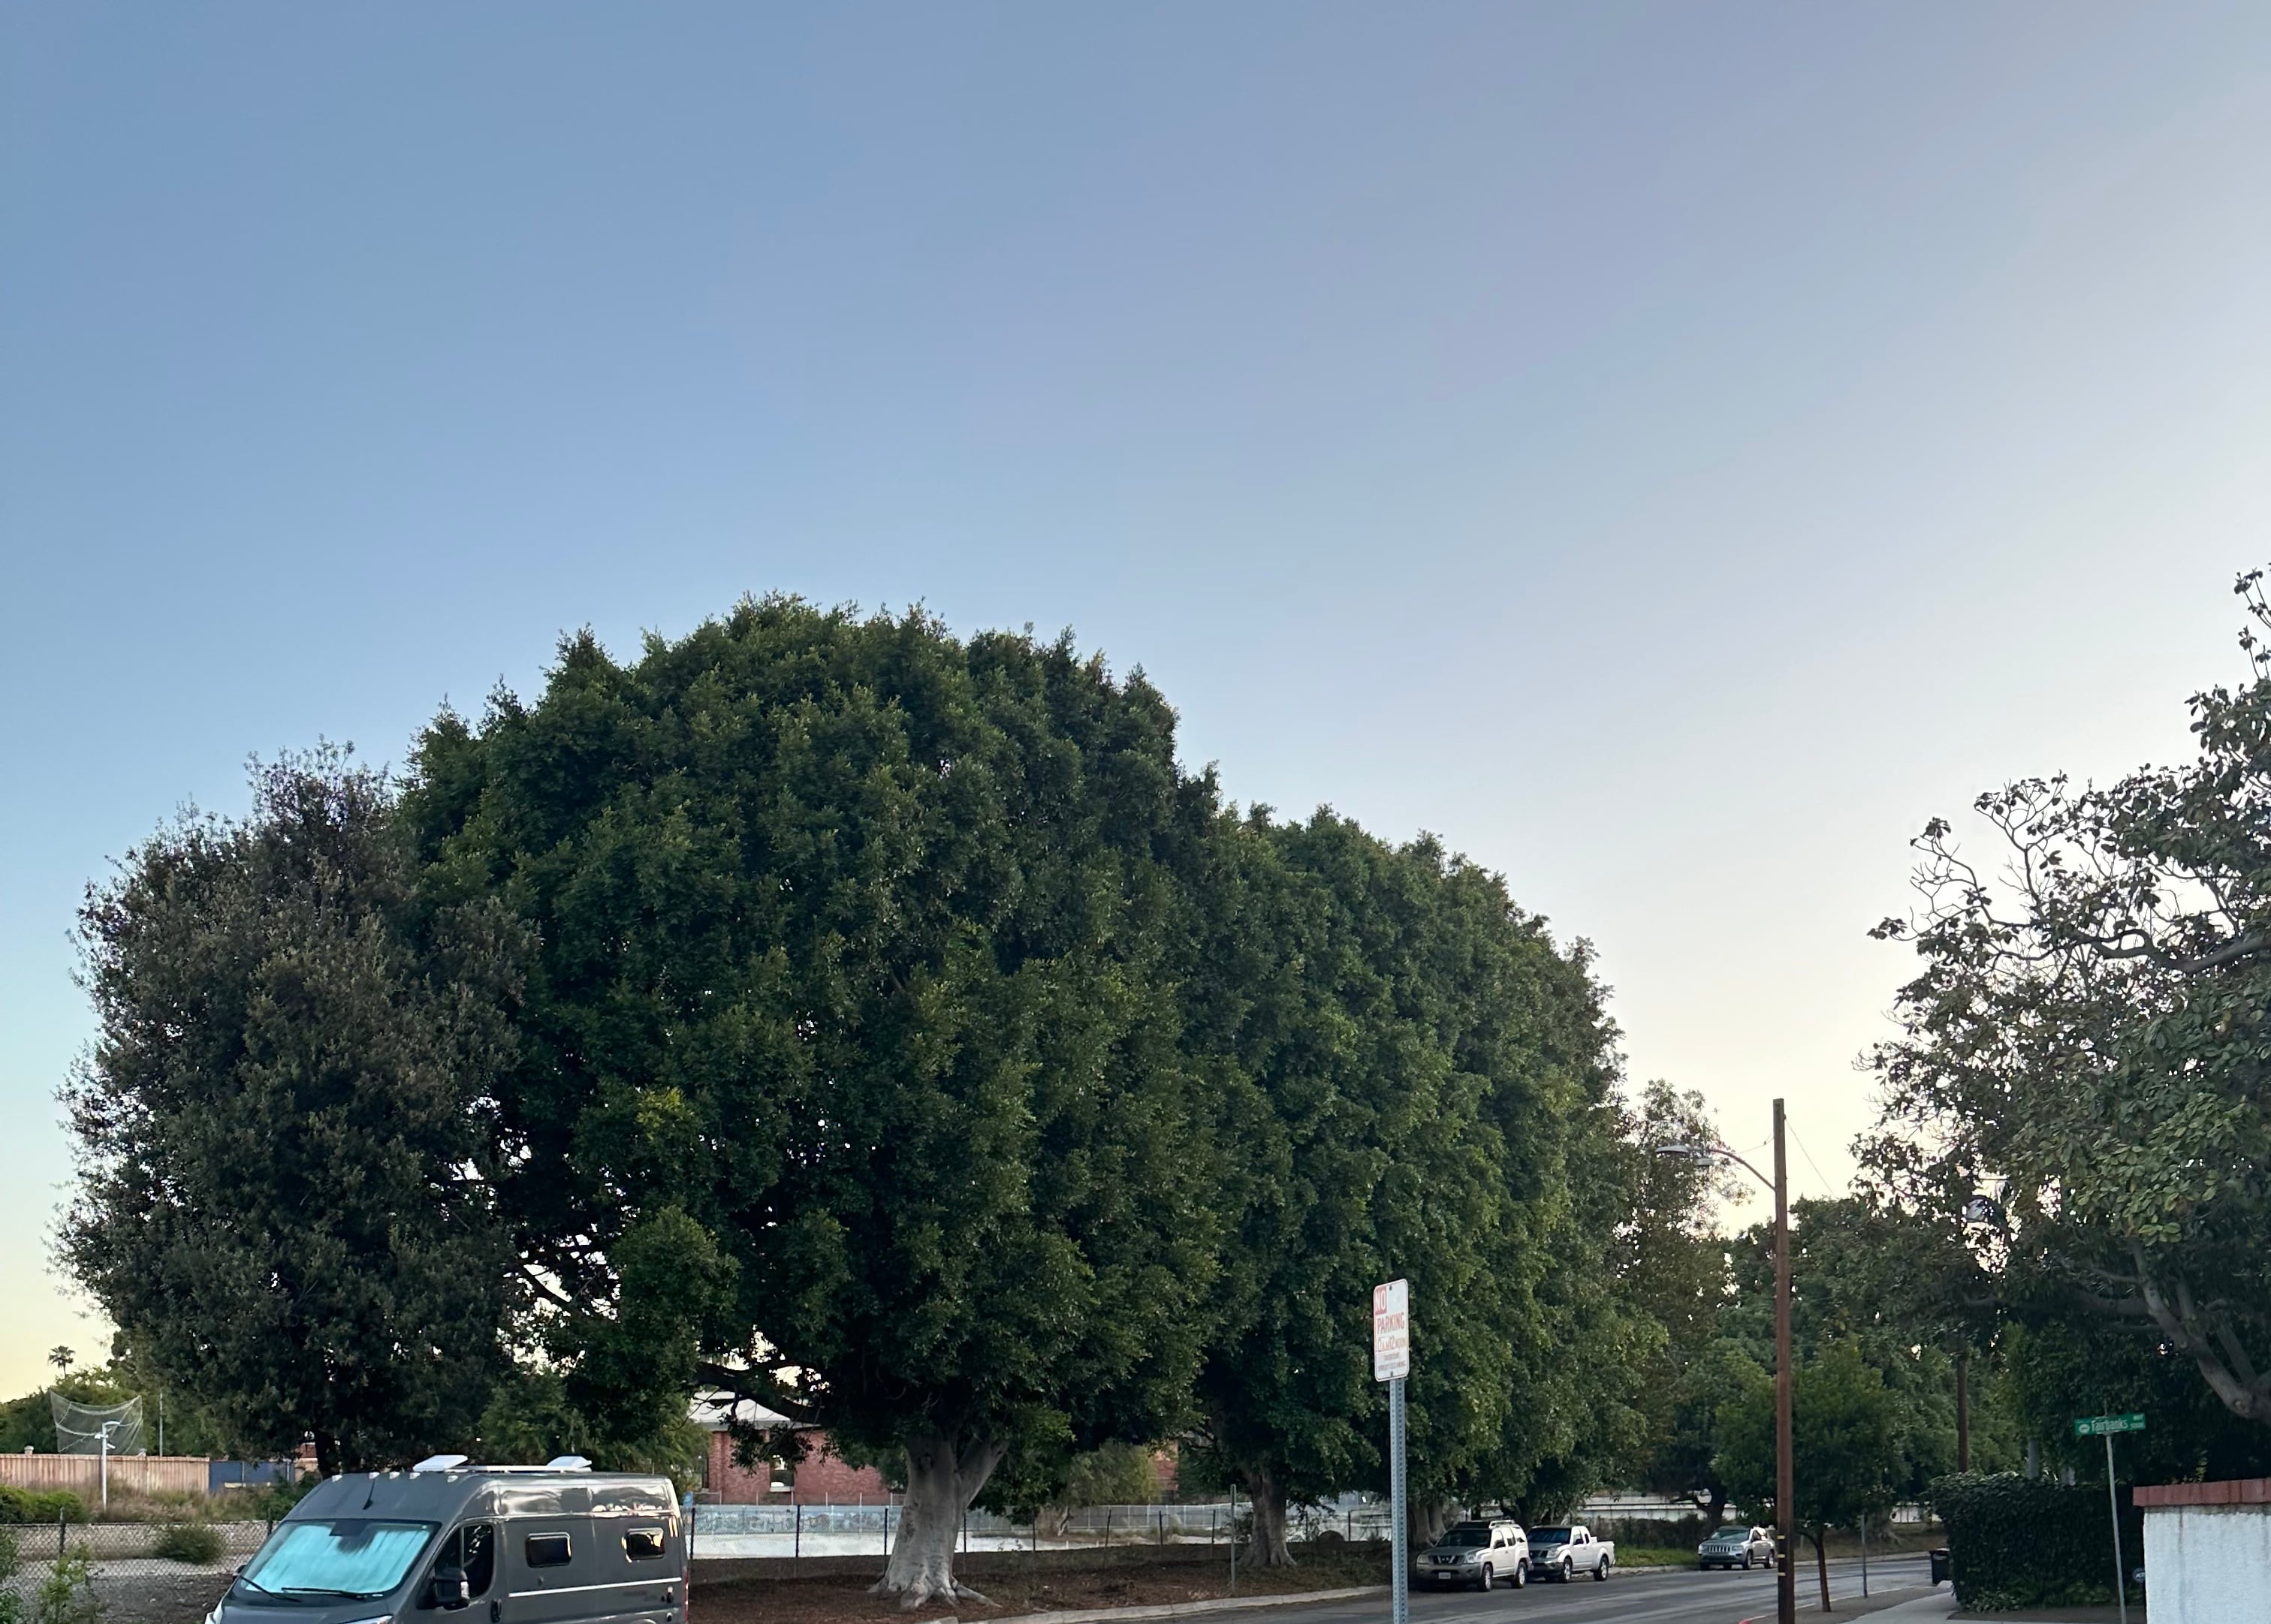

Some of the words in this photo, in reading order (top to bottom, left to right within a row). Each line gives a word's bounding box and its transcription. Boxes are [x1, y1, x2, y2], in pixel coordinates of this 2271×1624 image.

[1375, 1290, 1386, 1312] NO
[1377, 1312, 1405, 1335] PARKING
[2091, 1418, 2128, 1432] Fairbanks
